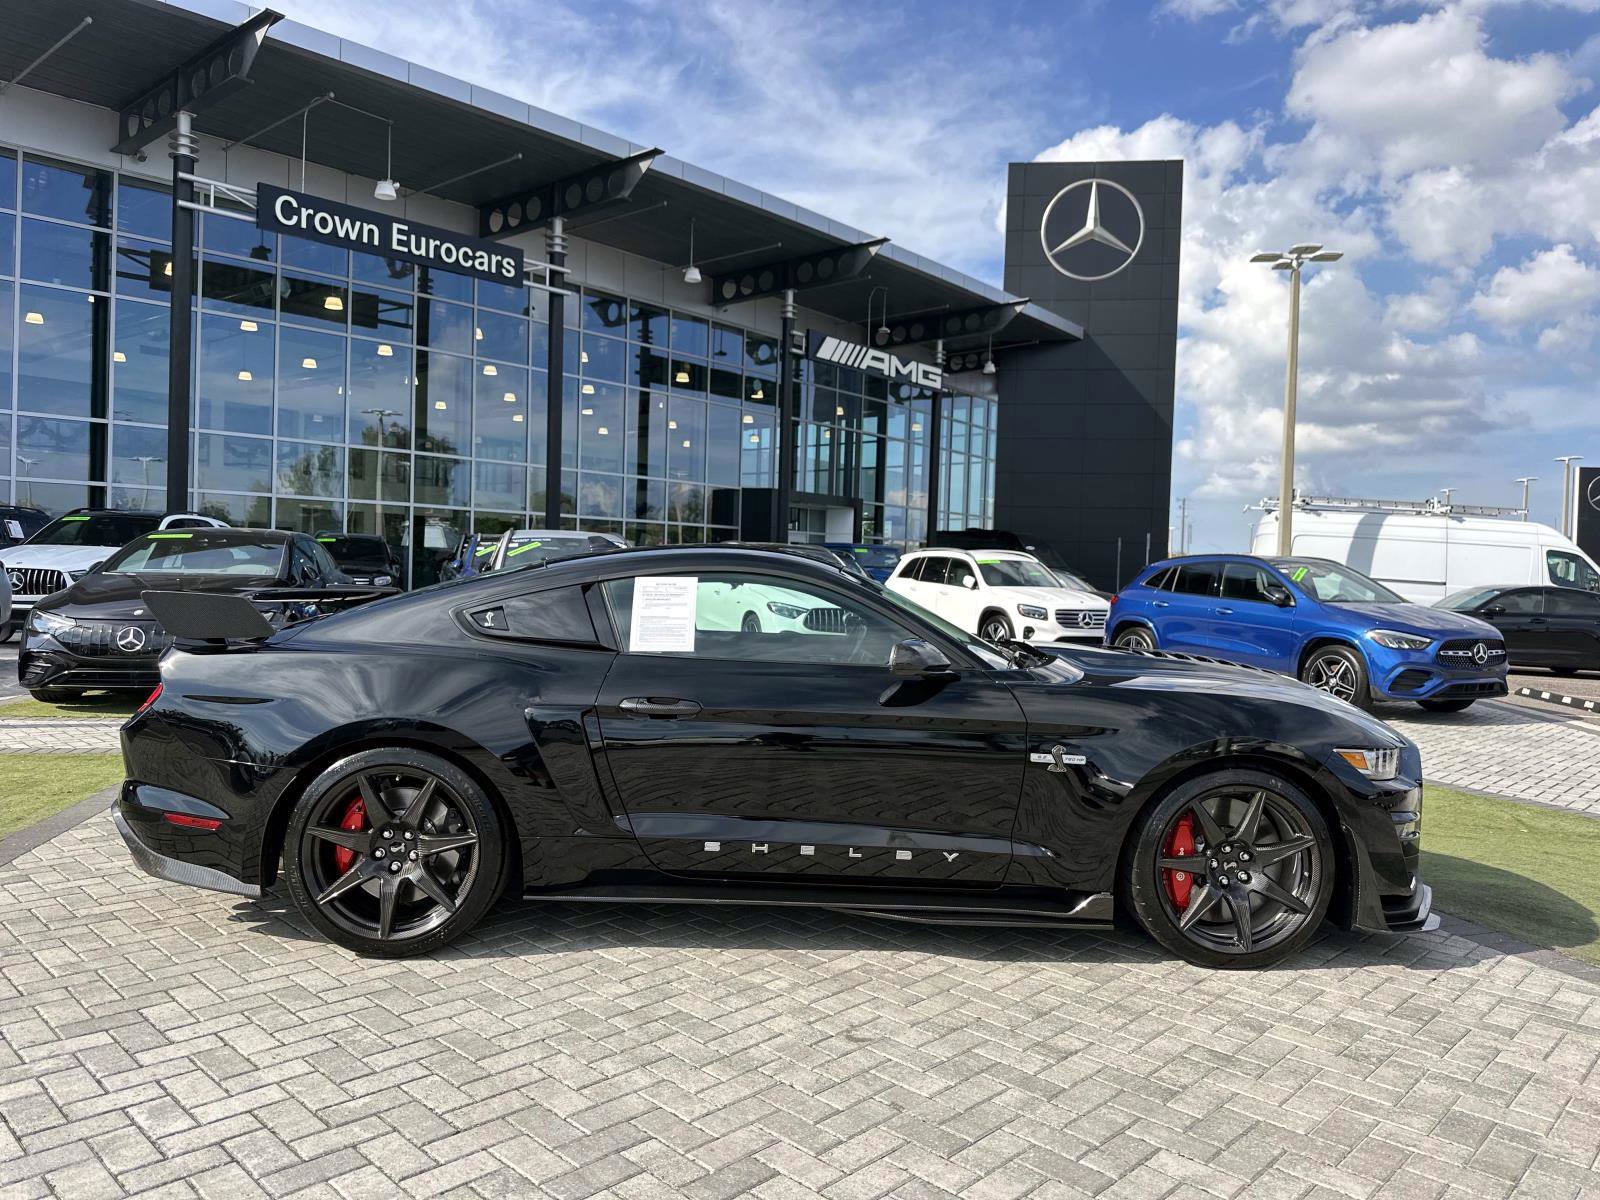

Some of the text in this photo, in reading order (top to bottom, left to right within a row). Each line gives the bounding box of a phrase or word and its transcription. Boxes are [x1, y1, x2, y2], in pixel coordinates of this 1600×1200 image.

[274, 194, 516, 278] Crown Eurocars
[859, 348, 941, 389] AMG
[704, 841, 959, 862] SHELBY
